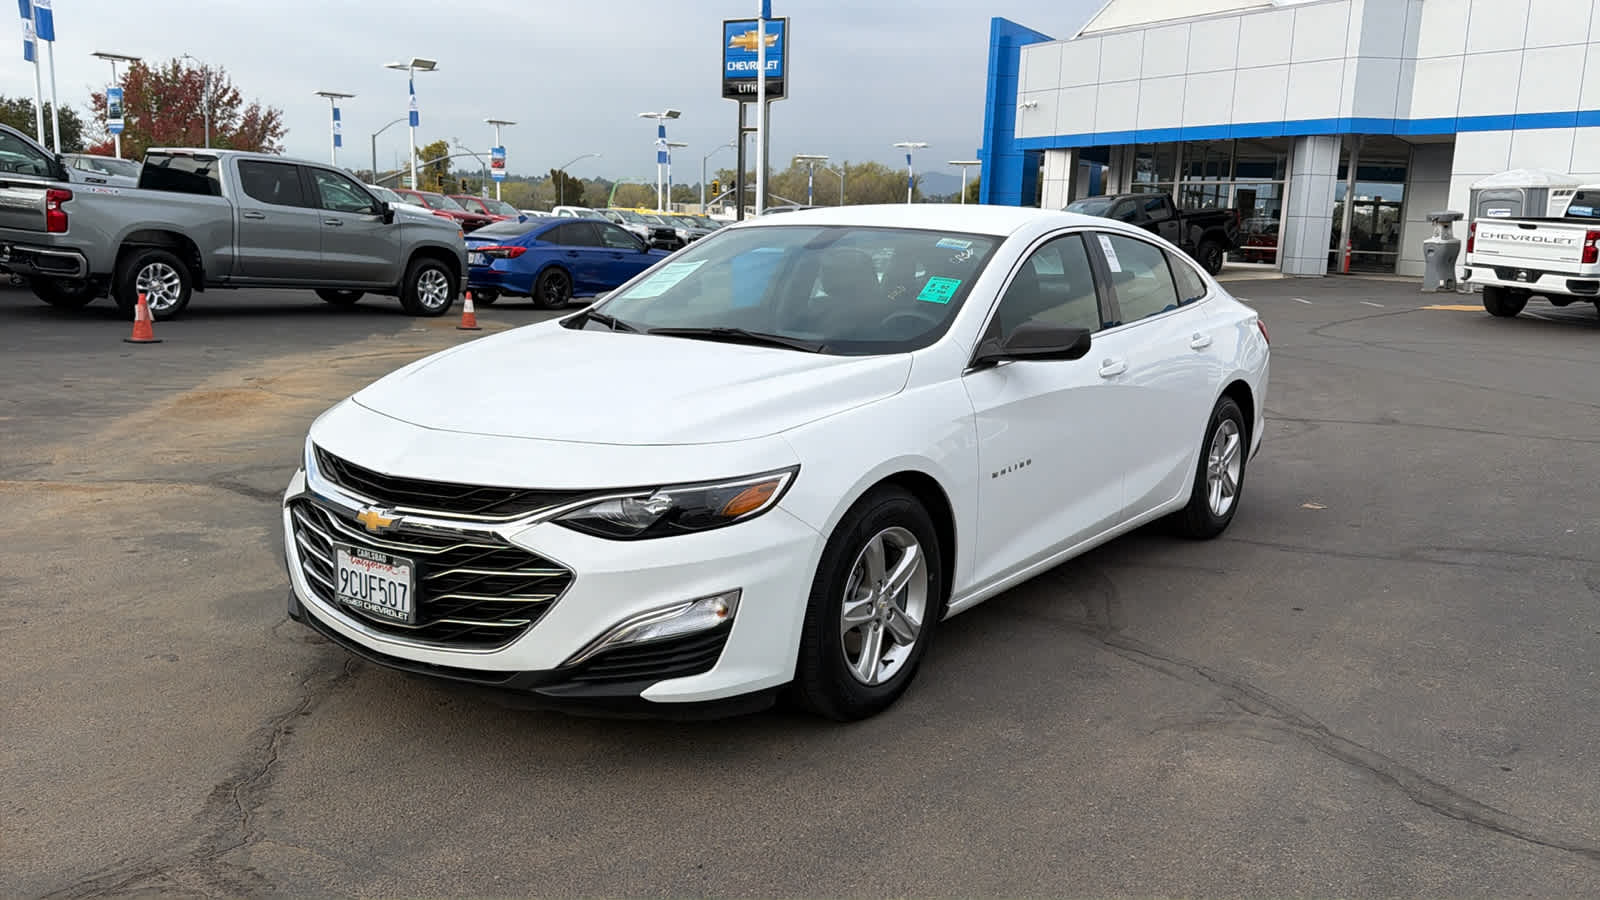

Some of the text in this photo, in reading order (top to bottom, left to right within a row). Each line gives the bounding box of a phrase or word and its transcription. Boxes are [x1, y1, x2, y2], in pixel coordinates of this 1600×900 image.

[727, 60, 778, 71] CHEVRLET
[738, 84, 758, 93] LITH
[1481, 231, 1573, 245] CHEVROLET
[340, 567, 408, 611] 9CUF507
[363, 601, 409, 621] CHEVROLET
